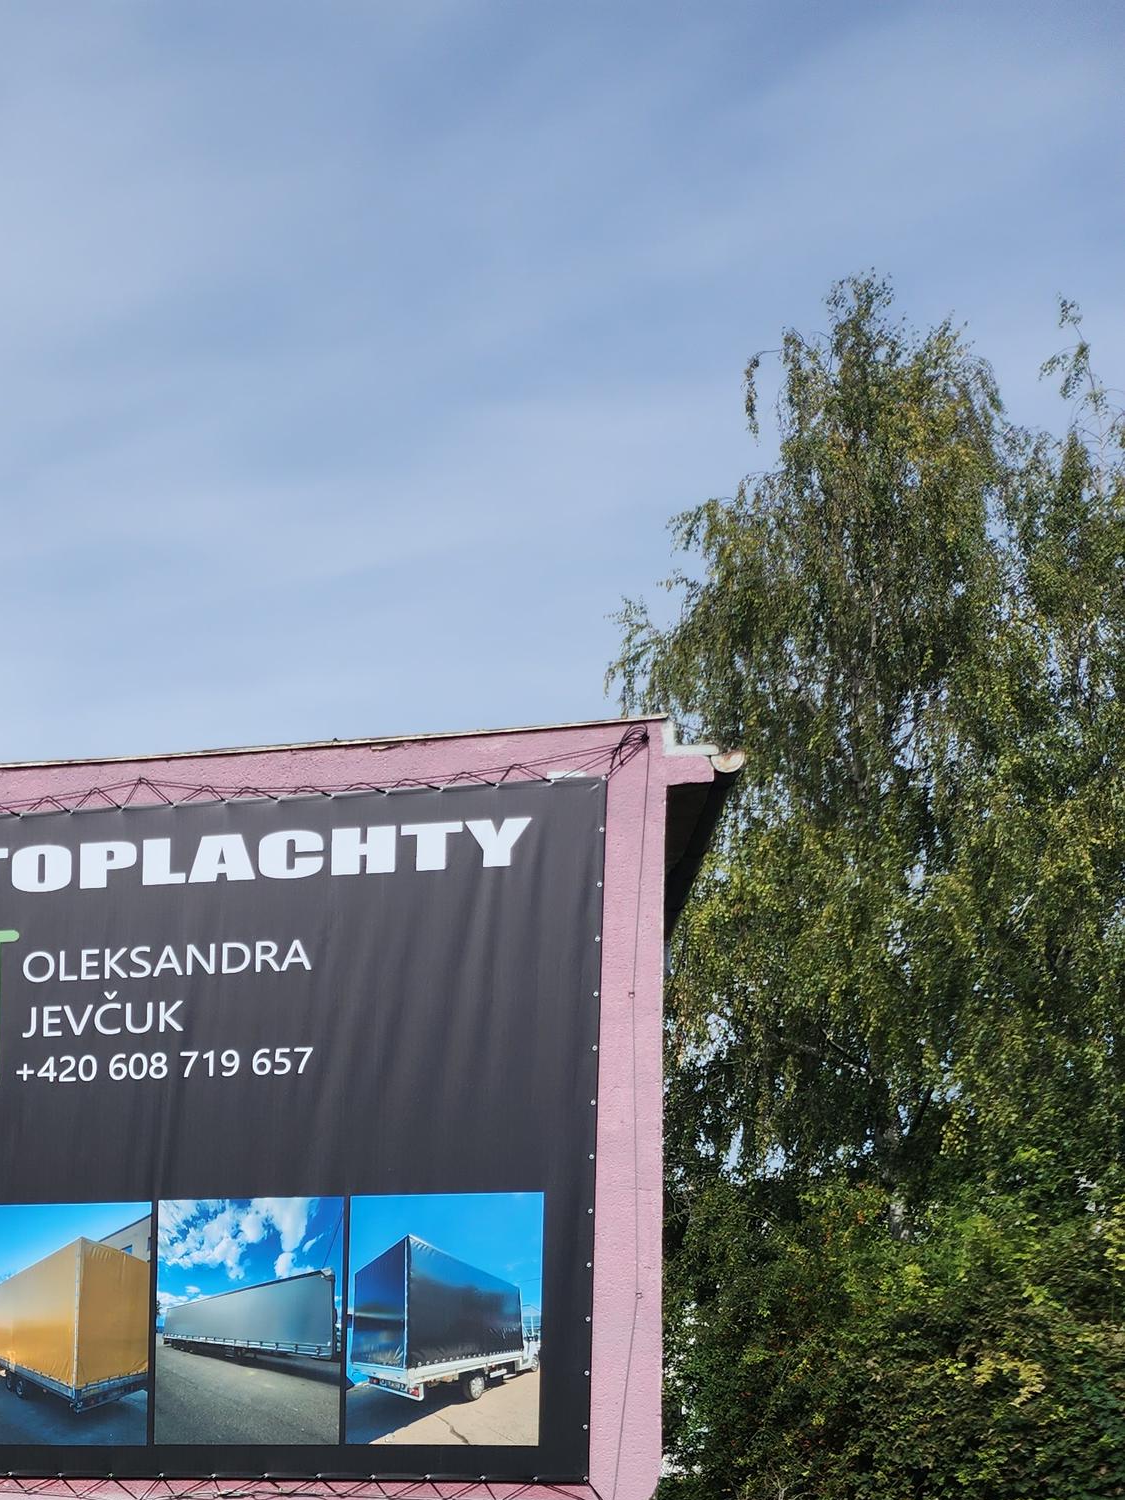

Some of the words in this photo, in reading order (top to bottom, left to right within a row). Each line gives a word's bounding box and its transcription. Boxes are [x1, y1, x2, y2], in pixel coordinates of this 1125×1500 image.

[22, 938, 312, 983] OLEKSANDRA
[21, 990, 184, 1039] JEVČUK
[15, 1054, 98, 1083] +420
[108, 1051, 169, 1081] 608
[179, 1048, 241, 1078] 719
[251, 1046, 314, 1076] 657
